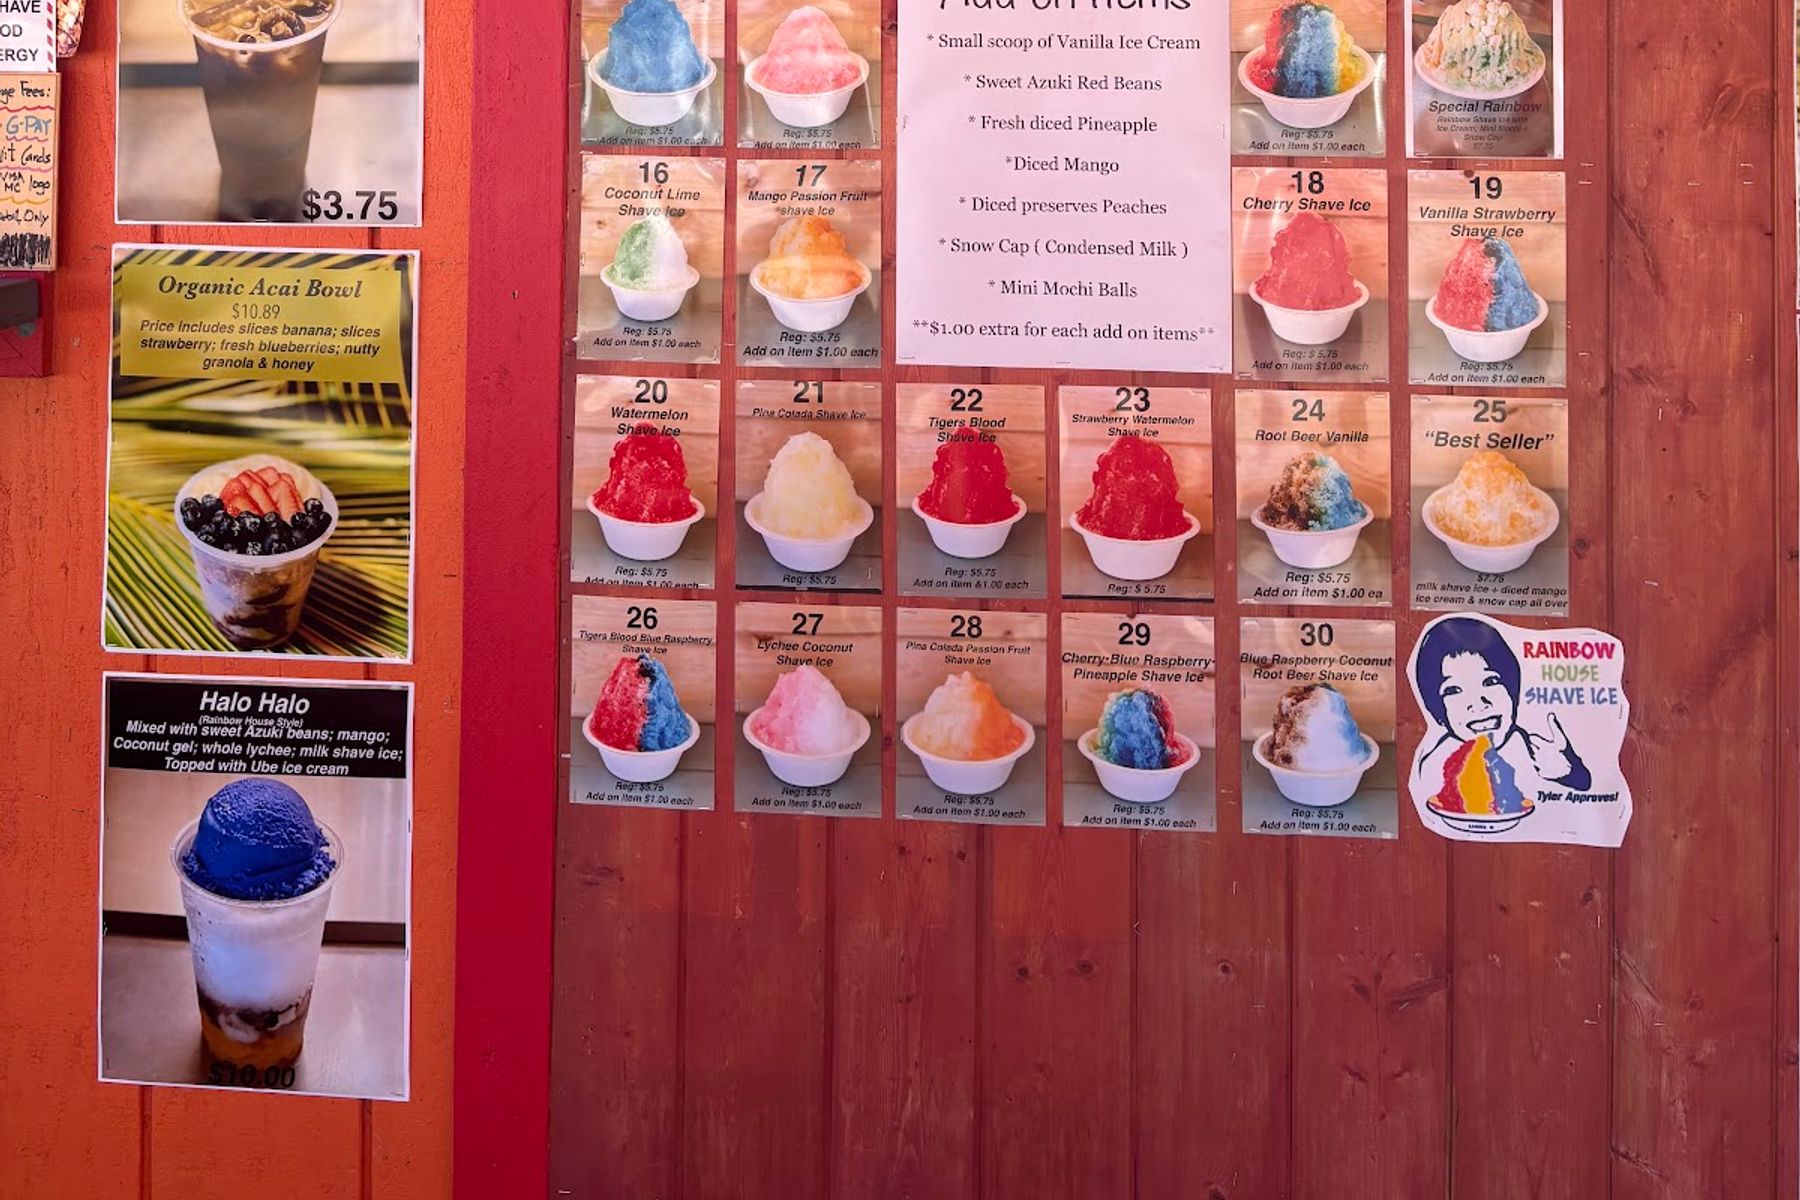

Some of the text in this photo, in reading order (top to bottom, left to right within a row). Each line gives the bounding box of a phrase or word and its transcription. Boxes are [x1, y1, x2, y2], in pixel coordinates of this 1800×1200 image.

[0, 0, 41, 13] HAVE
[938, 33, 1200, 52] Small scoop of Vanilla Ice Cream
[20, 80, 50, 97] Fees:
[1429, 100, 1542, 114] Special Rainbow
[981, 115, 1158, 135] Fresh diced Pineapple
[639, 162, 669, 184] 16
[795, 164, 828, 187] 17
[1291, 171, 1325, 194] 18
[1469, 176, 1502, 199] 19
[604, 188, 700, 201] Coconut Lime
[301, 187, 398, 223] $3.75
[1419, 207, 1555, 223] Vanilla Strawberry
[1450, 224, 1524, 238] Shave Ice
[158, 275, 362, 299] Organic Acai Bowl
[1000, 280, 1138, 297] Mini Mochi Balls
[232, 303, 280, 320] $10.89
[140, 320, 381, 338] Price includes slices banana; slices
[780, 331, 841, 343] Reg: $5.75
[743, 346, 879, 358] Add on item $1.00 each
[634, 379, 668, 403] 20
[611, 406, 689, 421] Watermelon
[1291, 399, 1325, 422] 24
[1473, 399, 1508, 423] 25
[617, 423, 680, 437] Shave Ice
[1255, 429, 1369, 443] Root Beer Vanilla
[792, 613, 824, 636] 27
[1118, 622, 1151, 646] 29
[1300, 623, 1334, 646] 30
[757, 640, 853, 653] Lychee Coconut
[1523, 641, 1615, 659] RAINBOW
[1073, 668, 1204, 683] Pineapple Shave Ice
[1542, 664, 1599, 682] HOUSE
[200, 691, 310, 714] Halo Halo
[1525, 687, 1617, 705] SHAVE ICE
[114, 738, 403, 761] Coconut gel; whole lychee; milk shave ice;
[1537, 791, 1619, 803] Tyler Approves!
